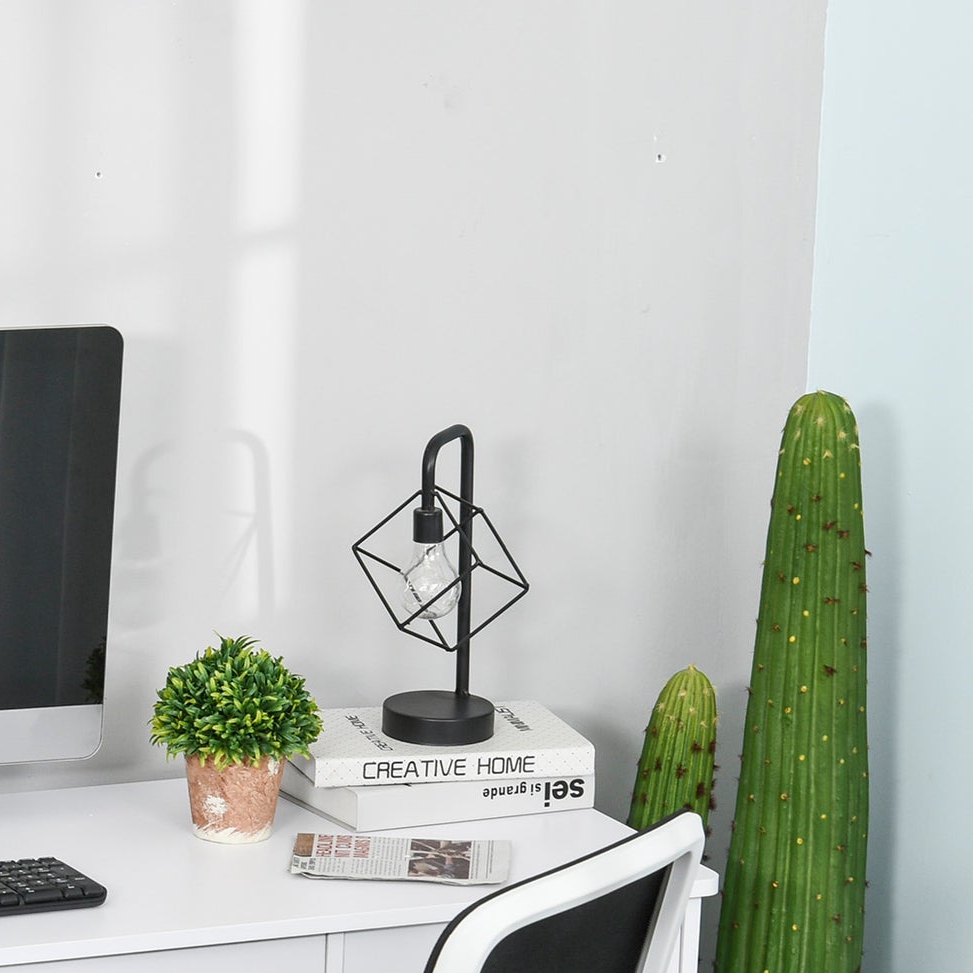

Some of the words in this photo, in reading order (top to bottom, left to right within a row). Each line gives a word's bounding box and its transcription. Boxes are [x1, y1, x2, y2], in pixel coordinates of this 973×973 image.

[362, 758, 467, 780] CREATIVE
[477, 755, 536, 775] HOME
[482, 781, 527, 799] grande
[544, 778, 585, 807] sei
